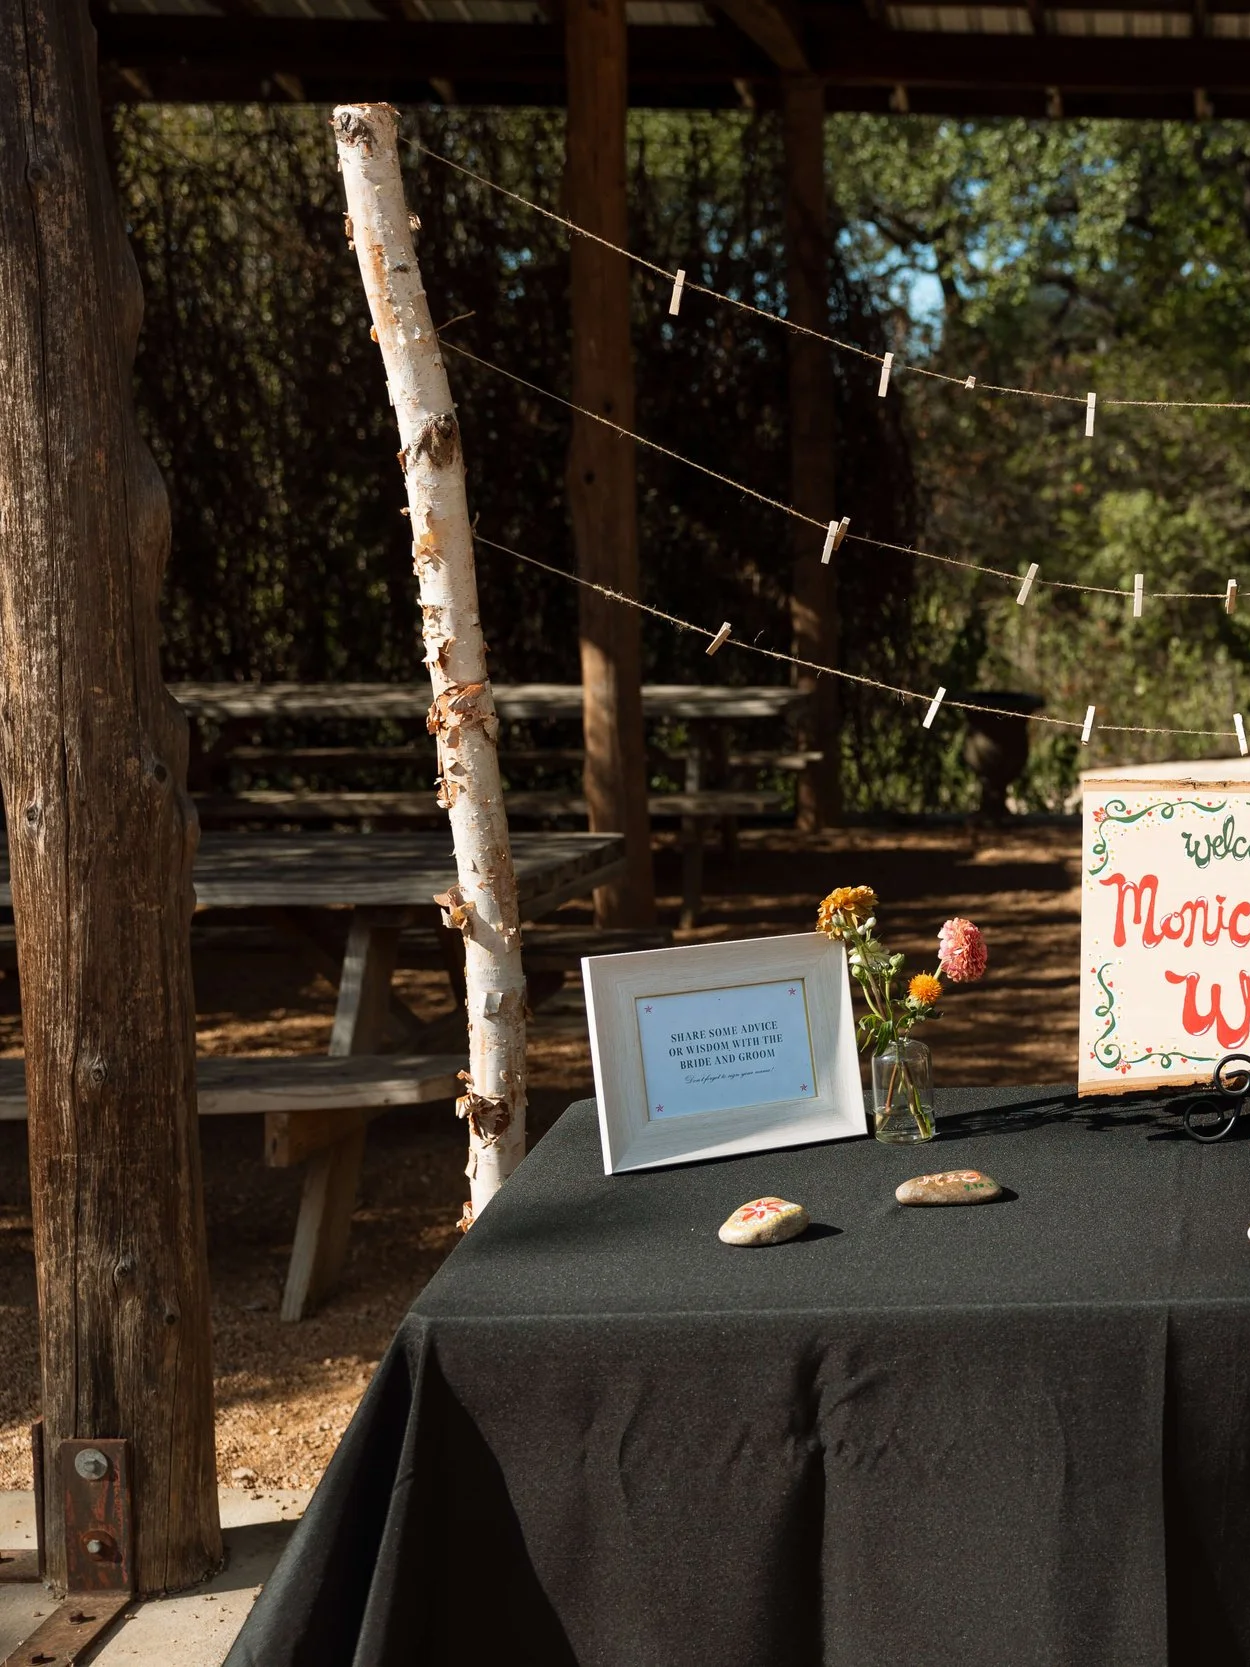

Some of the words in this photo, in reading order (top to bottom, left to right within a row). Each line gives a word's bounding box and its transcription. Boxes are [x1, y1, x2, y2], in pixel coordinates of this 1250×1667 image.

[670, 1029, 707, 1043] SHARE
[708, 1026, 738, 1038] SOME
[740, 1020, 778, 1034] ADVICE
[668, 1045, 684, 1057] OR
[686, 1041, 730, 1055] WISDOM
[732, 1037, 760, 1051] WITH
[762, 1033, 784, 1044] THE
[680, 1056, 712, 1070] BRIDE
[714, 1054, 736, 1066] AND
[738, 1049, 776, 1062] GROOM
